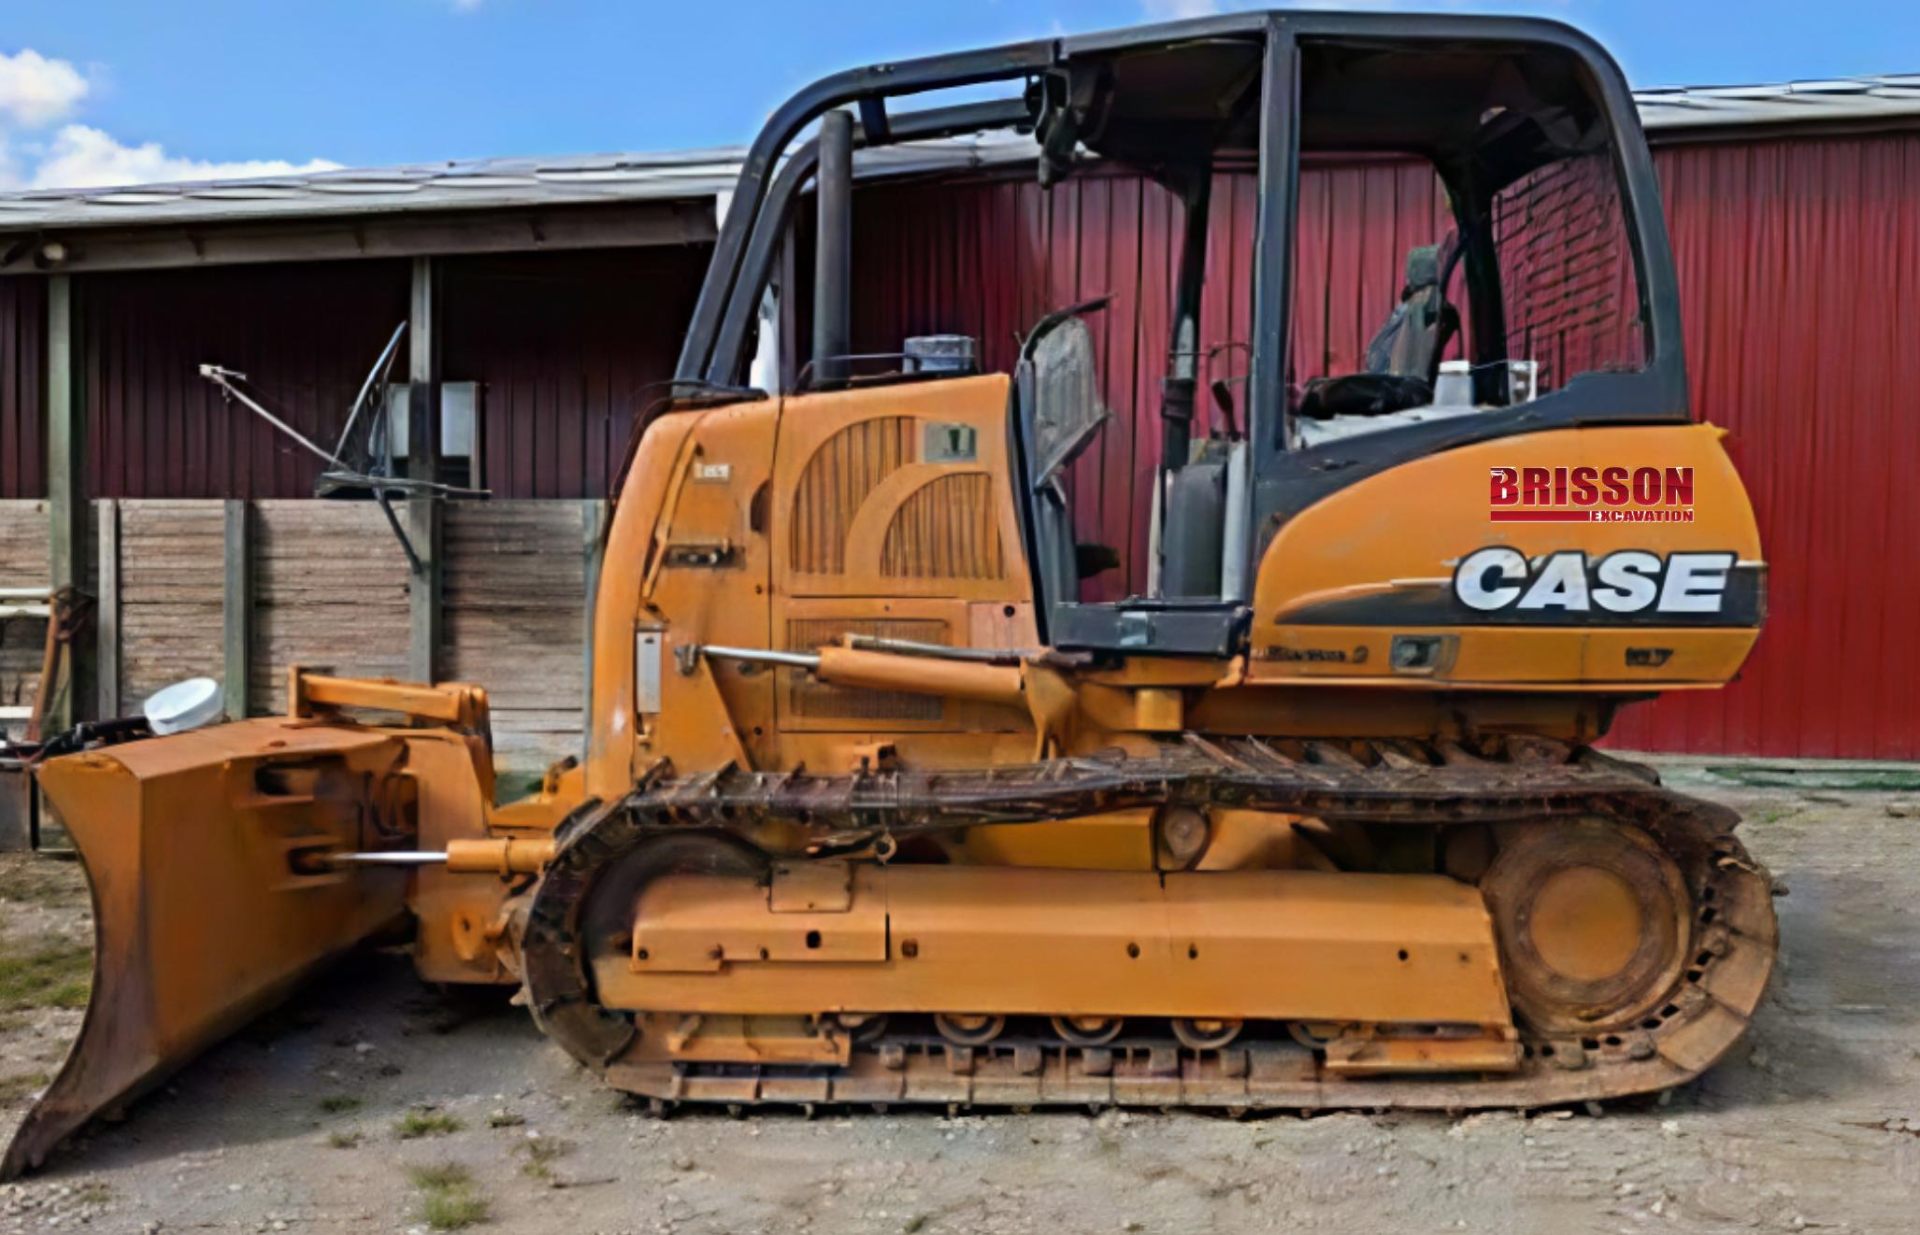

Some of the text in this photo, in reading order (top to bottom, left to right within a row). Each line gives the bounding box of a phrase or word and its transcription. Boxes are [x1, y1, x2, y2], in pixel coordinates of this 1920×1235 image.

[1490, 467, 1694, 505] BRISSON
[1590, 510, 1694, 522] EXCAVATION
[1456, 548, 1734, 612] CASE
